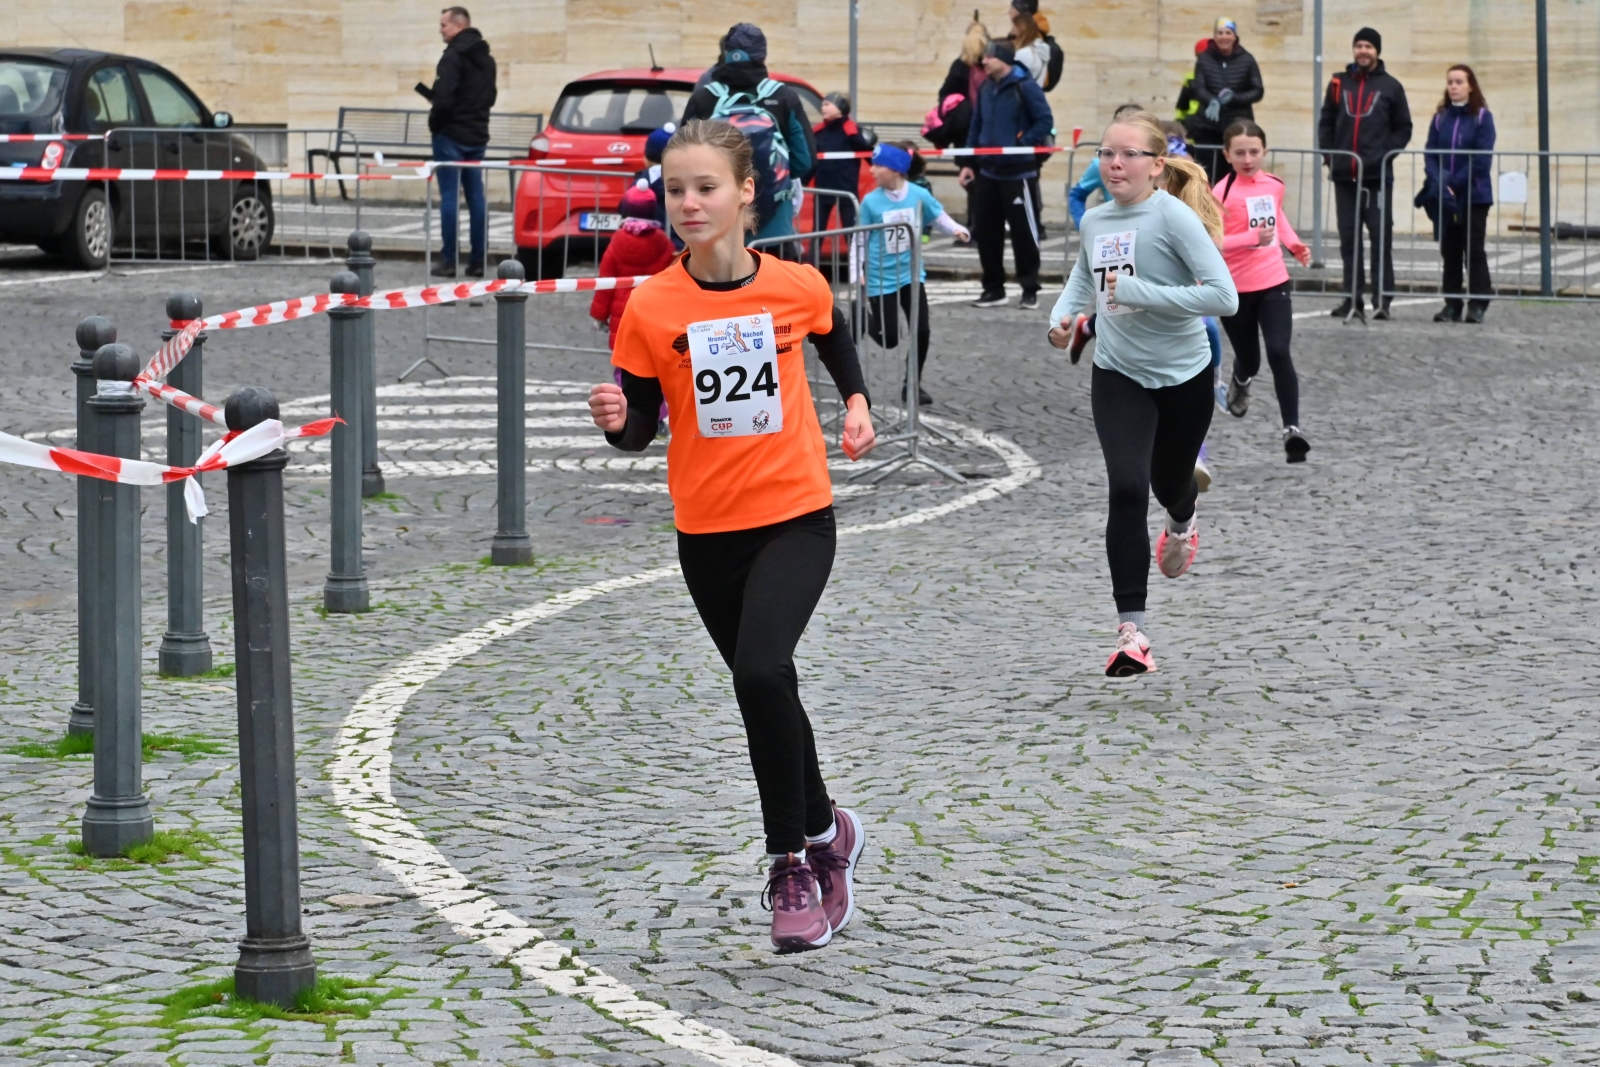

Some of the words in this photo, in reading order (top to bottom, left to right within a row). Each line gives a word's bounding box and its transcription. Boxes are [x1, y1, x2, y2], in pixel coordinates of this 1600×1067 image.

[708, 334, 728, 342] Hronov
[742, 330, 764, 339] Náchod
[695, 361, 778, 405] 924
